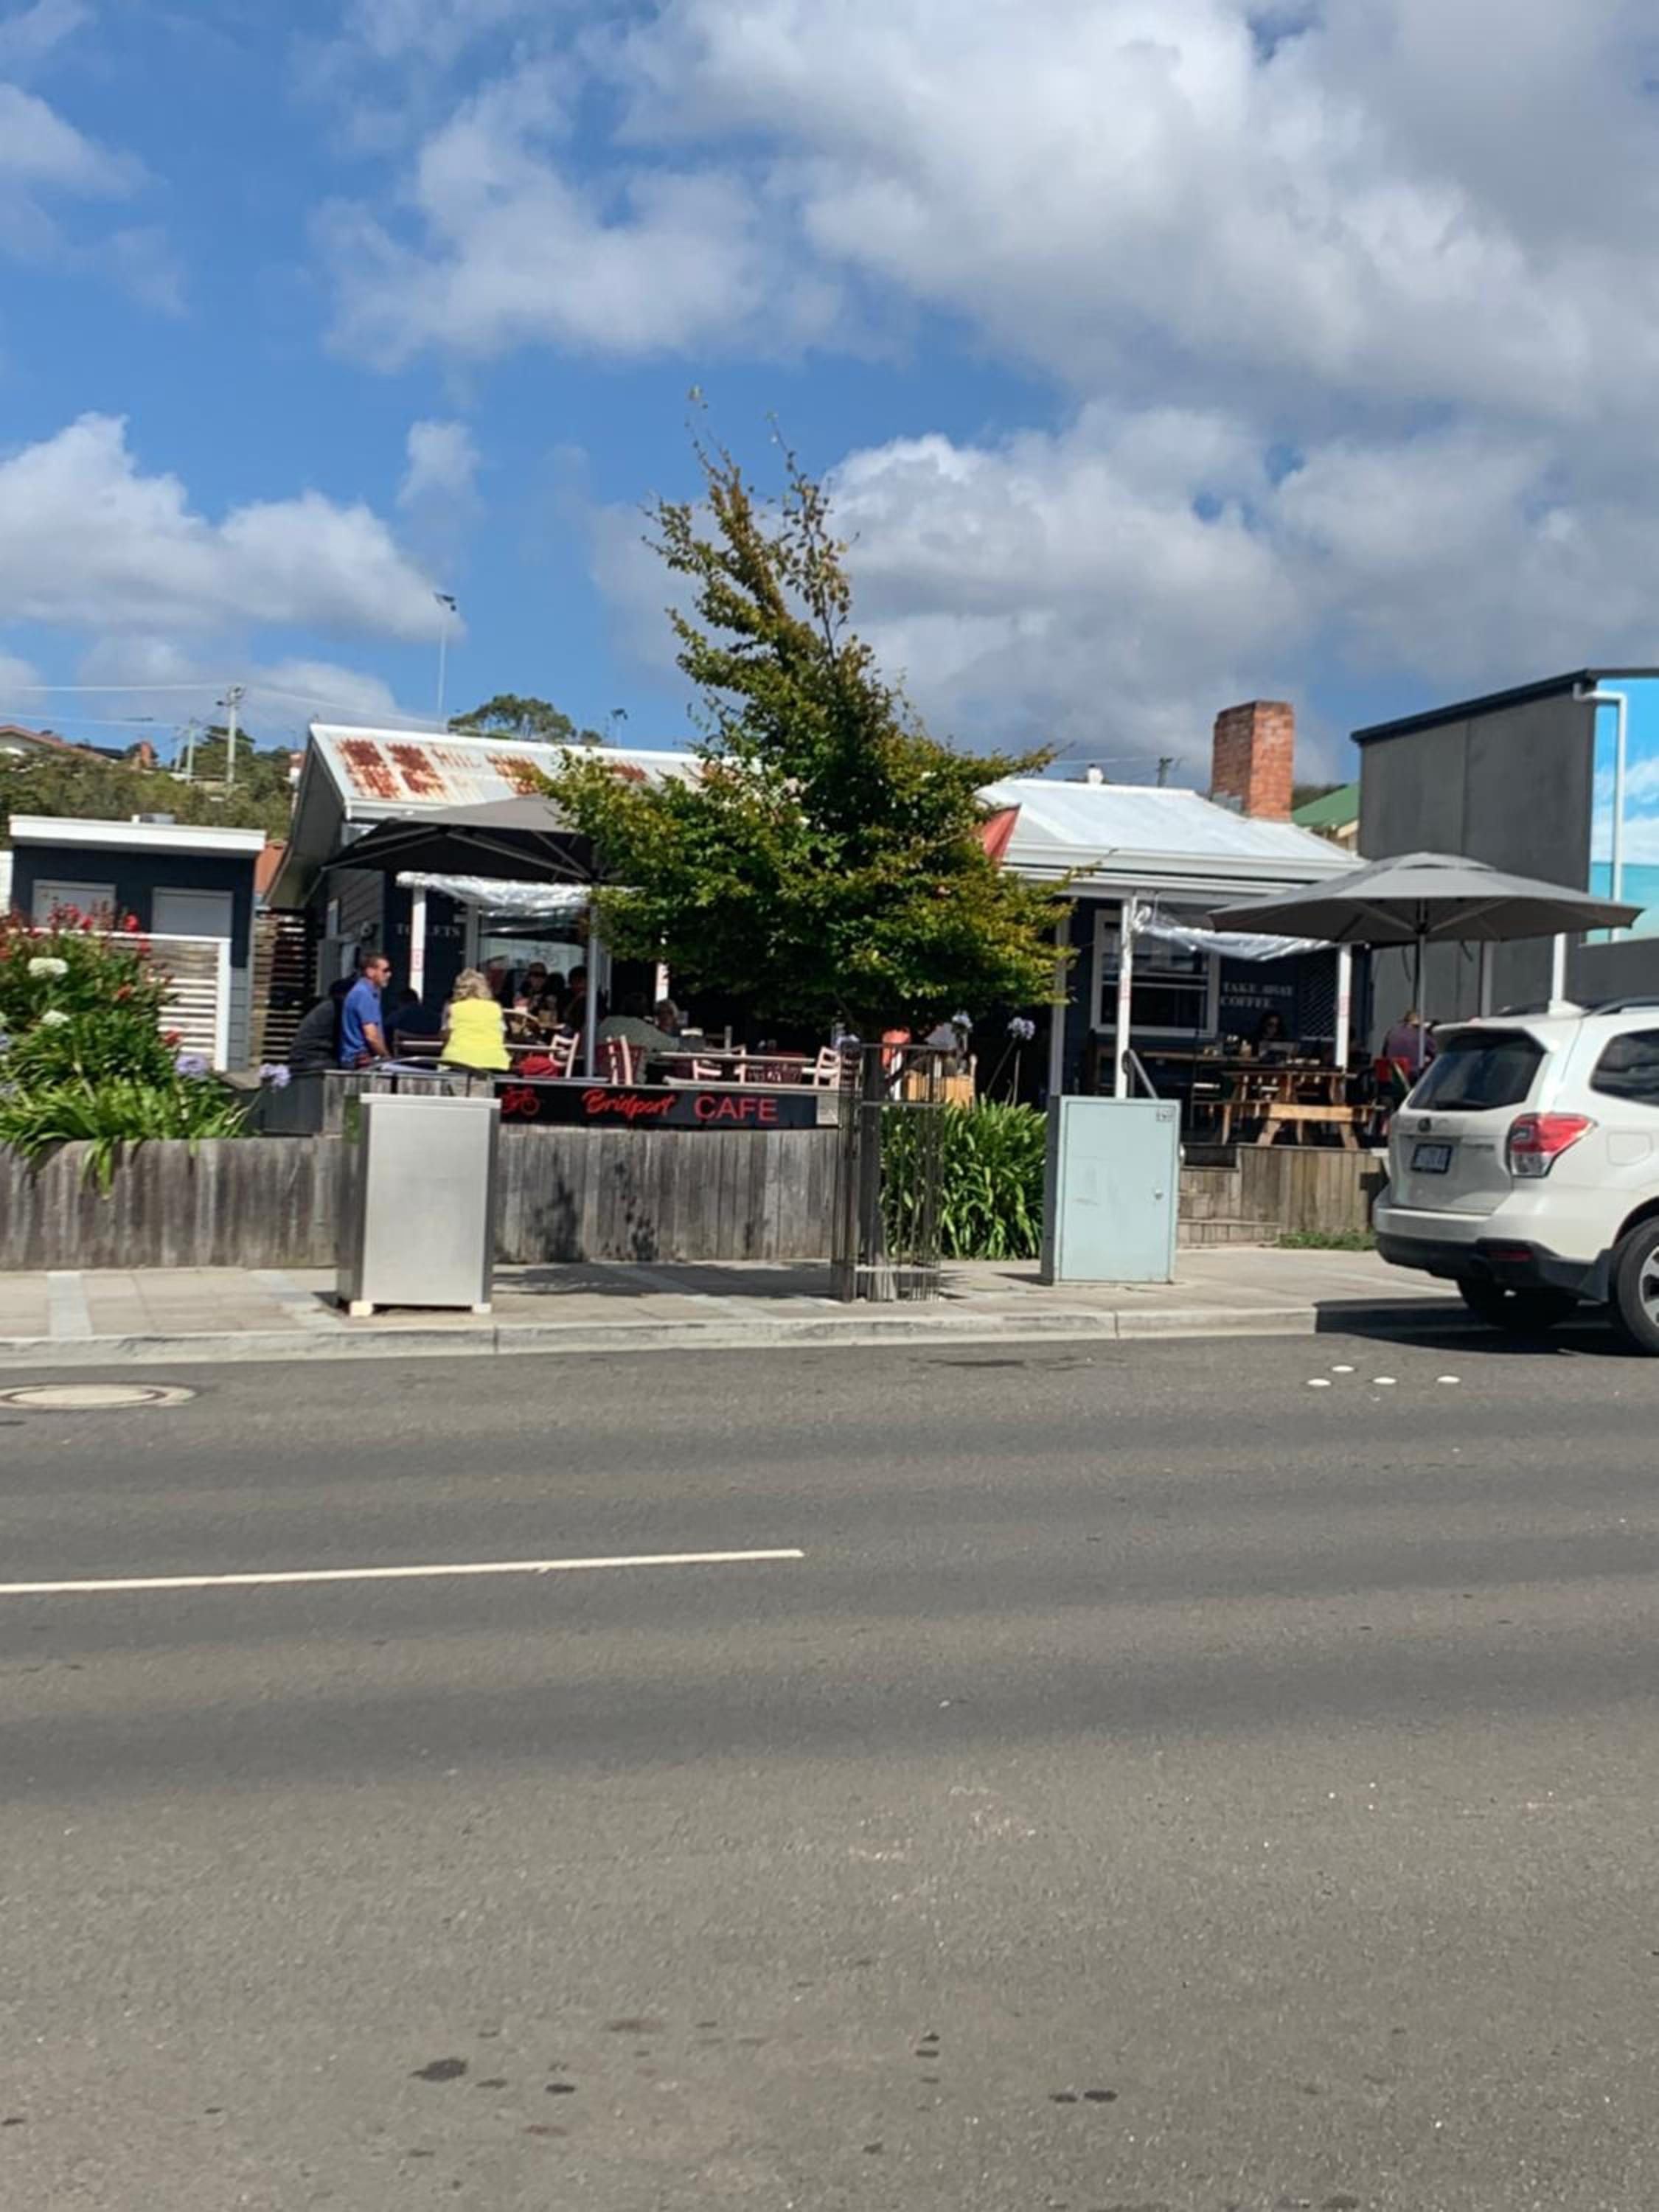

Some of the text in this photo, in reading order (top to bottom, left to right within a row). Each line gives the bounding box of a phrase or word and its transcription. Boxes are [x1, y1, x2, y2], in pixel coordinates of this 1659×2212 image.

[396, 922, 461, 937] TETS
[582, 1088, 779, 1121] Bridport CAFE
